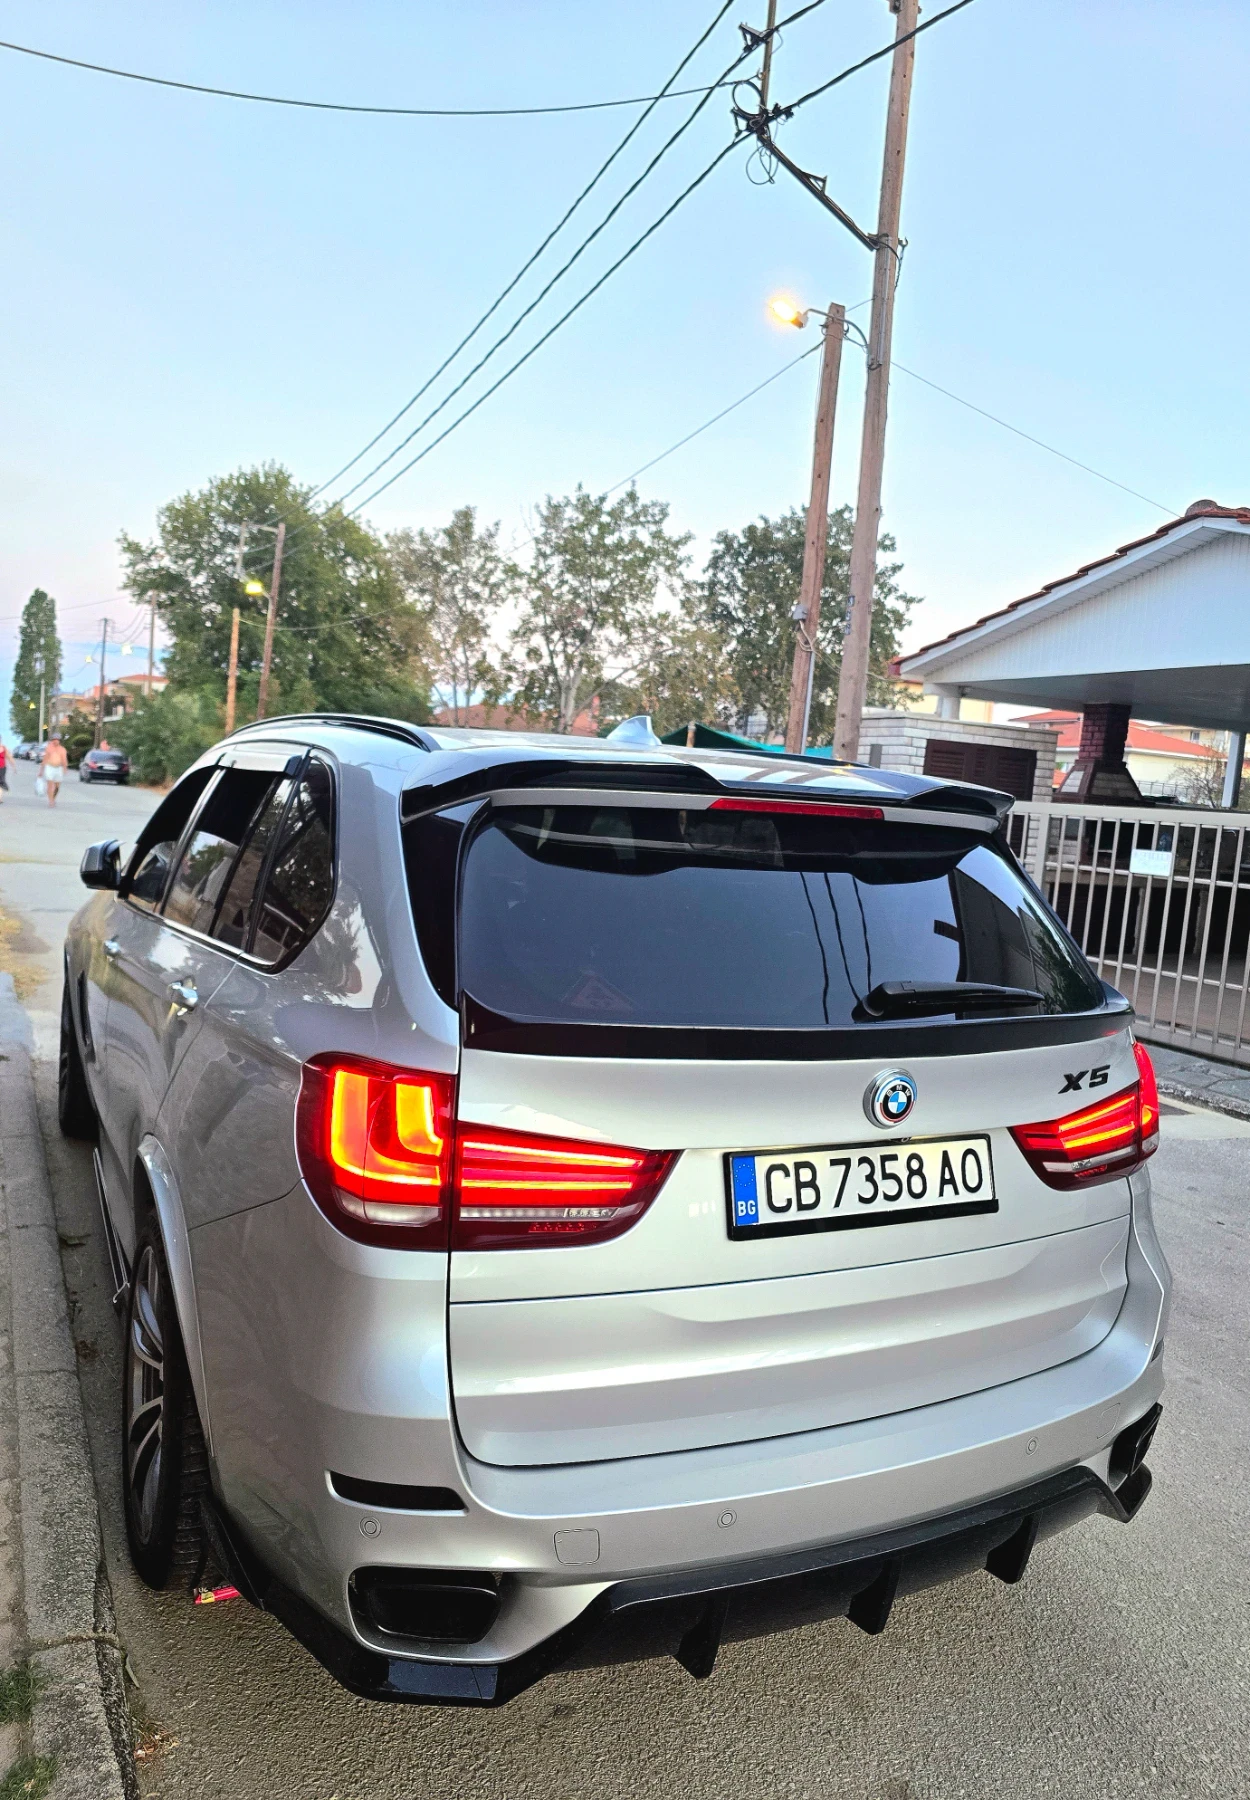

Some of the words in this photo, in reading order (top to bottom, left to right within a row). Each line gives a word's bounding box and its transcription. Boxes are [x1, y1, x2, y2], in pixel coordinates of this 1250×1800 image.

[886, 1084, 911, 1097] BMW
[1057, 1064, 1111, 1094] X5
[765, 1160, 821, 1213] CB
[829, 1152, 928, 1209] 7358
[938, 1148, 983, 1198] AO
[737, 1200, 756, 1217] BG
